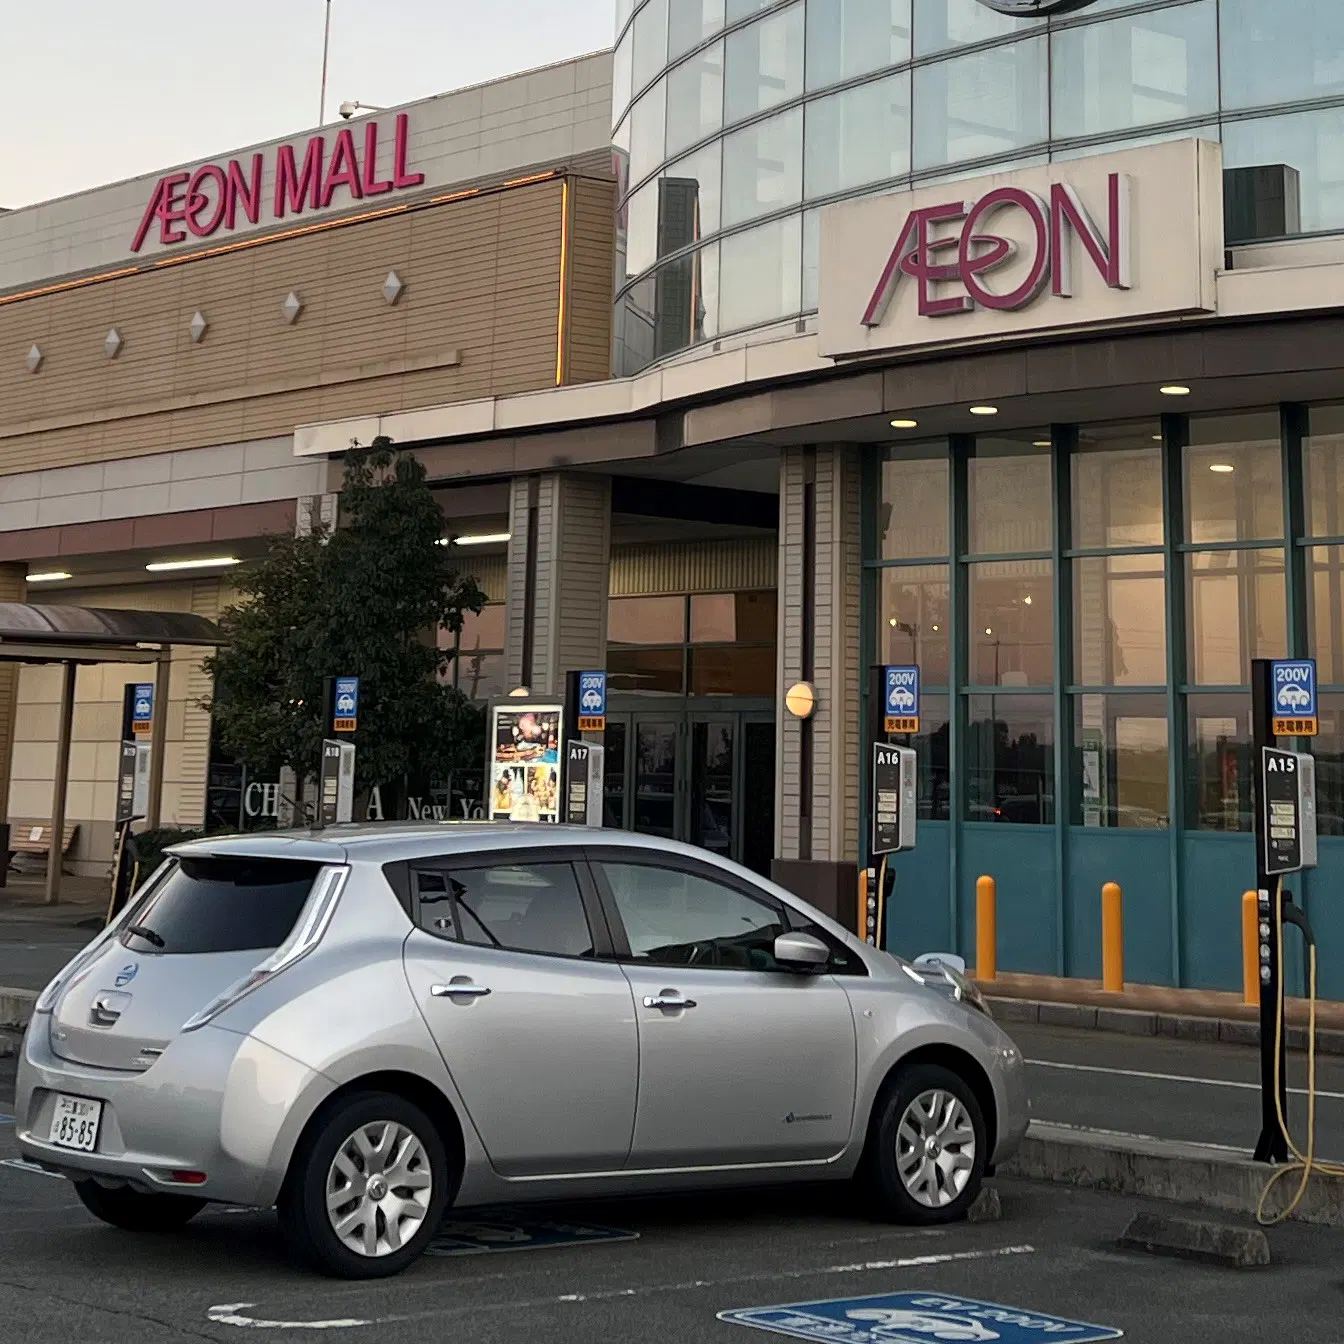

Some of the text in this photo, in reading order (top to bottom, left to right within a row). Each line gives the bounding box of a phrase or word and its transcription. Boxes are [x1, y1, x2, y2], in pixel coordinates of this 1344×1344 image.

[274, 114, 425, 218] MALL
[888, 672, 915, 686] 200V
[1276, 668, 1309, 682] 200V
[582, 677, 604, 689] 200V
[570, 748, 588, 760] A17
[877, 751, 899, 765] A16
[1267, 757, 1295, 773] A15
[408, 796, 448, 821] New
[459, 798, 485, 820] Yo
